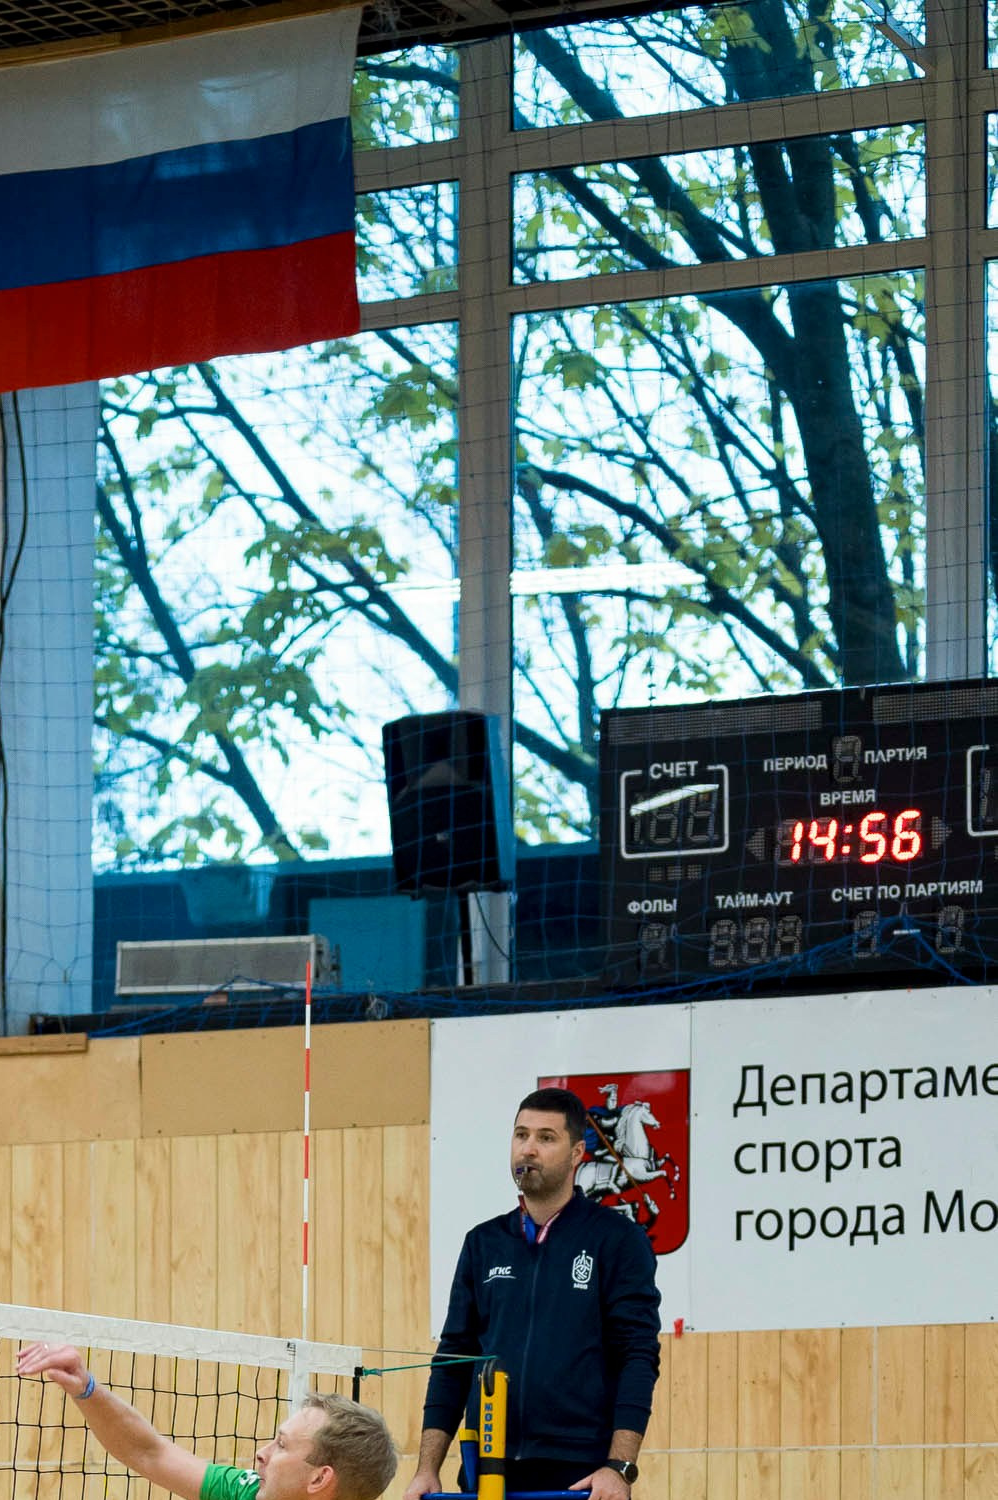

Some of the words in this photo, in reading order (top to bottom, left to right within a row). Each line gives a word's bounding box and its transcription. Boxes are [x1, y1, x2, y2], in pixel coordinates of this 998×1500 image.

[763, 754, 827, 772] ПЕРИОД
[864, 746, 927, 764] ПАРТИЯ
[649, 761, 698, 779] СЧЕТ
[820, 789, 876, 806] ВРЕМЯ
[790, 809, 922, 863] 14:56
[715, 891, 794, 909] ТАЙМ-АУТ
[831, 887, 874, 902] СЧЕТ
[877, 884, 901, 899] ПО
[905, 880, 983, 897] ПАРТИЯМ
[627, 899, 677, 914] ФОЛЫ
[733, 1063, 998, 1118] Департаме
[734, 1136, 902, 1183] спорта
[735, 1203, 905, 1251] города
[923, 1189, 998, 1234] Мо
[484, 1403, 493, 1453] MONDO
